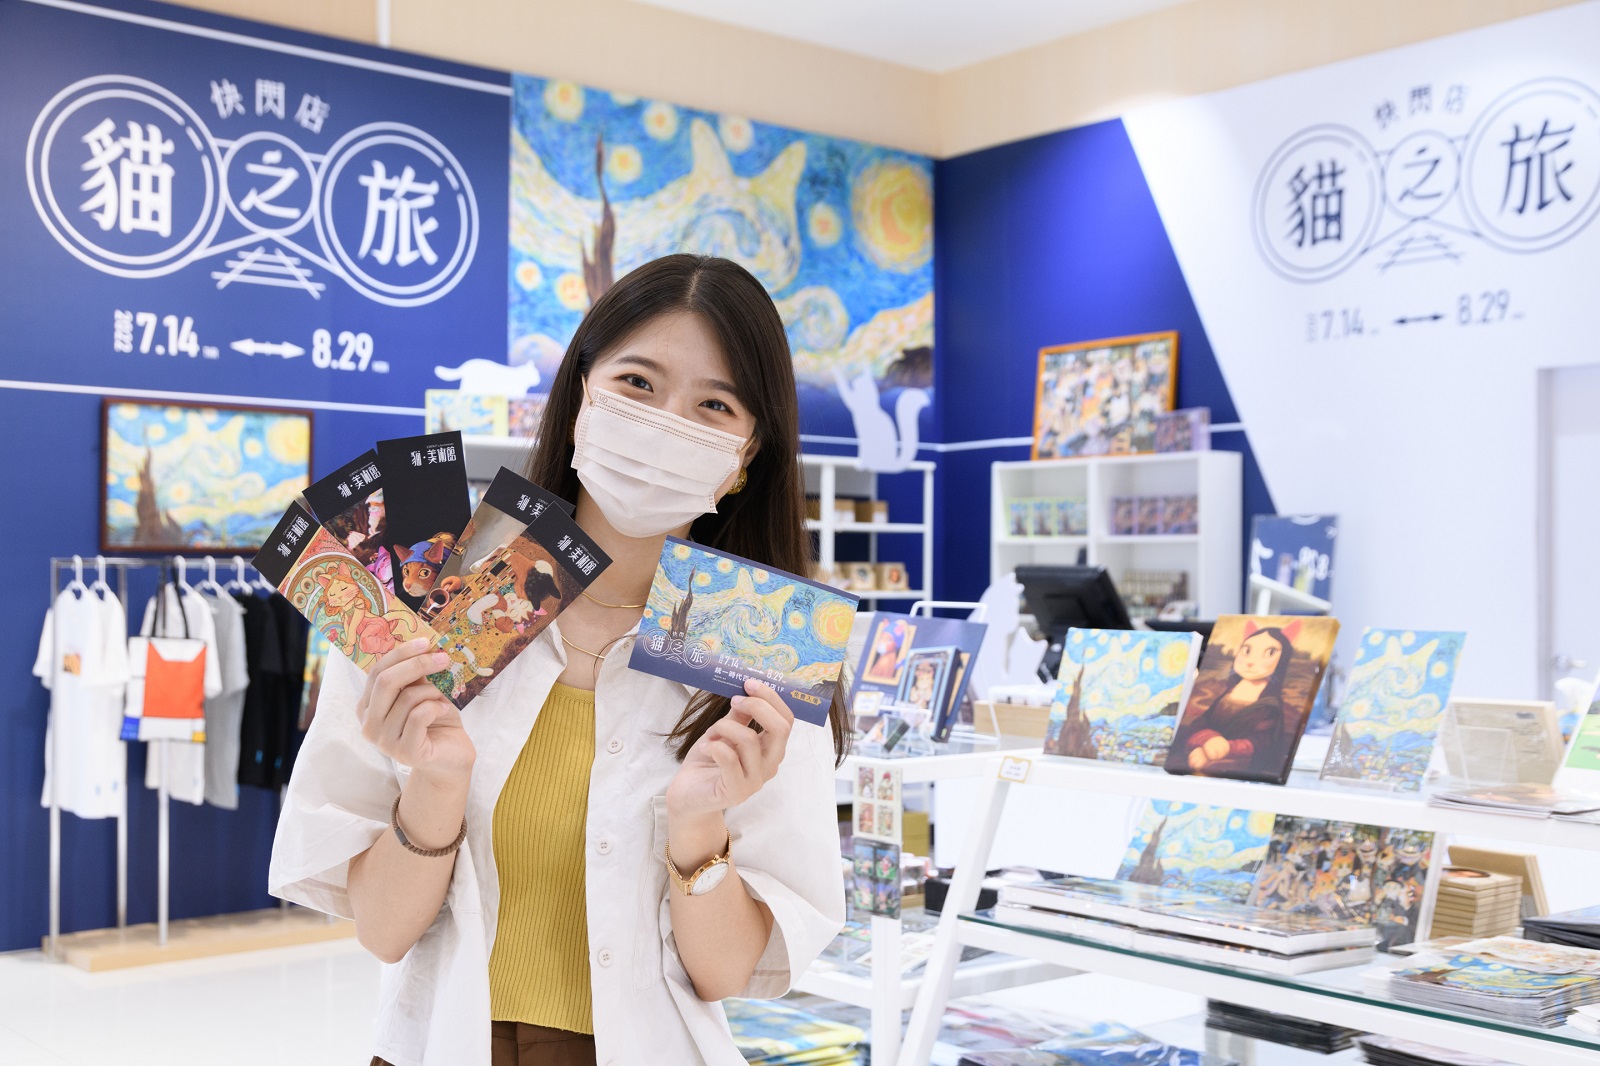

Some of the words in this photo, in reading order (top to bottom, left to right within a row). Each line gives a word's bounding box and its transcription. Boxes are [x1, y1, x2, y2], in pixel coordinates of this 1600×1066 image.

[210, 78, 330, 134] 快閃店
[79, 117, 439, 267] 貓之旅
[1284, 119, 1575, 249] 貓之旅
[136, 311, 200, 358] 7.14
[312, 328, 373, 372] 8.29
[1320, 306, 1363, 342] 7.14
[1456, 288, 1511, 326] 8.29
[650, 634, 705, 665] 貓之旅
[724, 655, 740, 669] 7.14
[767, 670, 784, 683] 8.29
